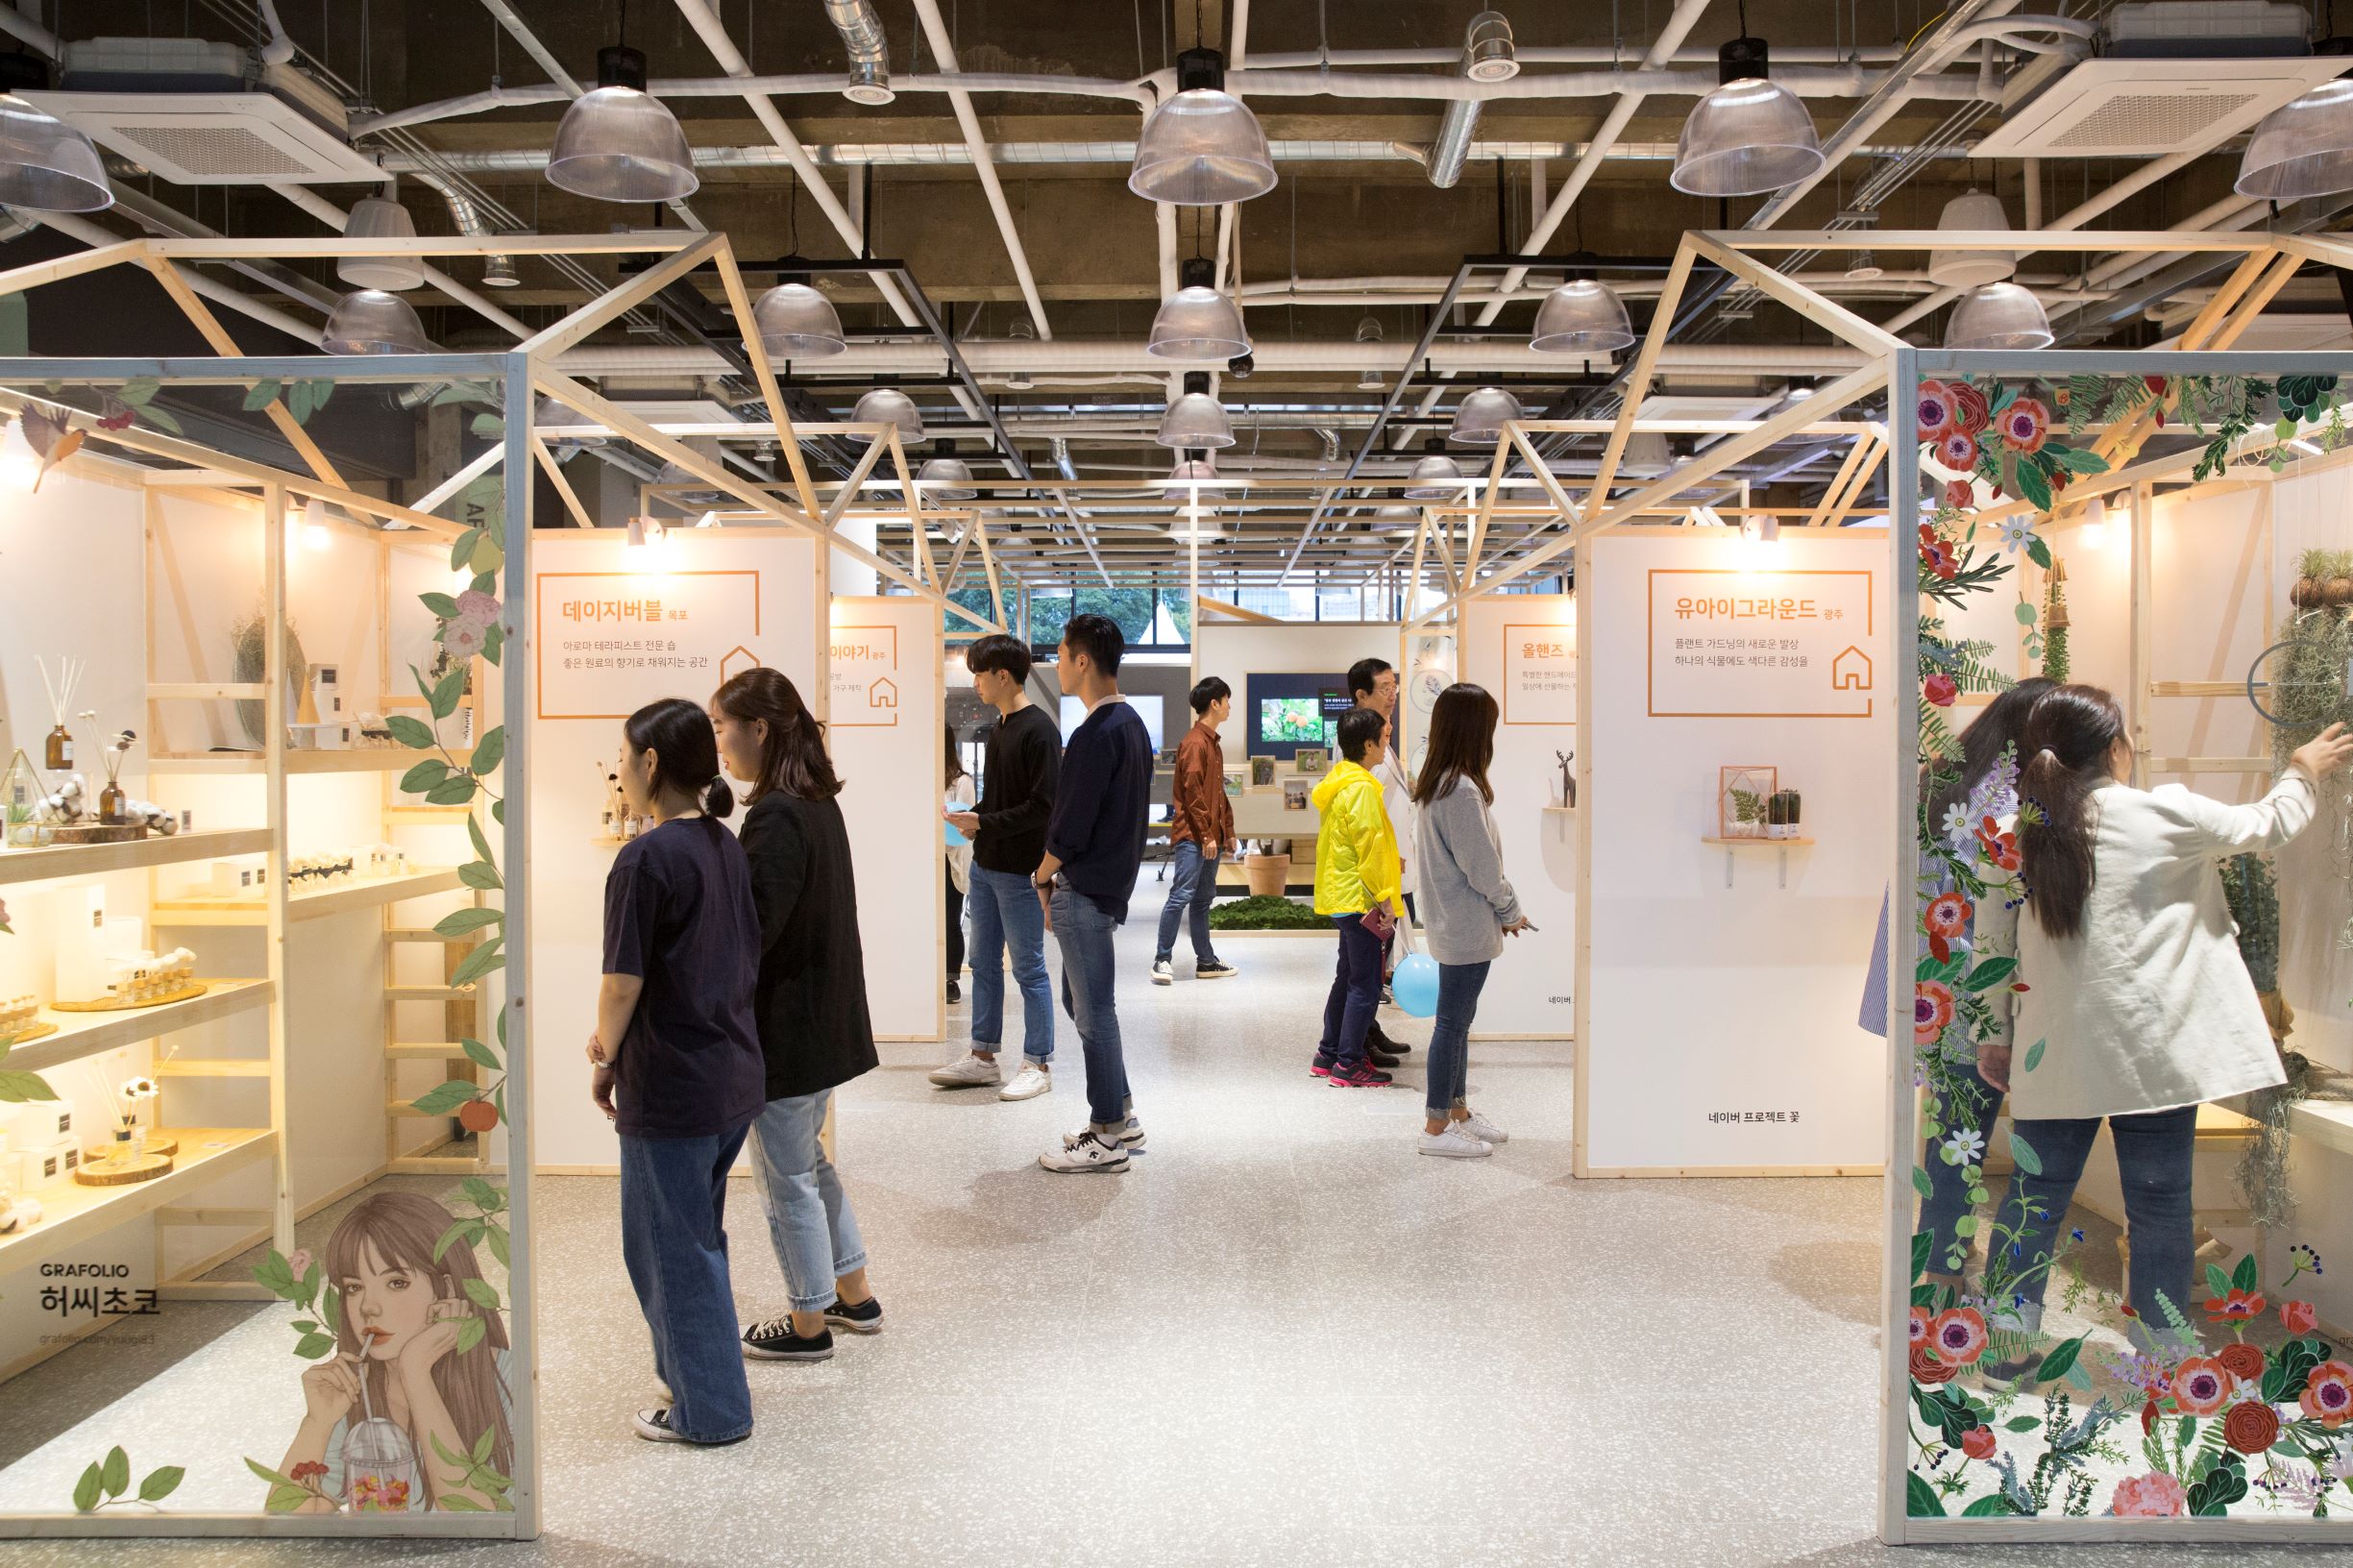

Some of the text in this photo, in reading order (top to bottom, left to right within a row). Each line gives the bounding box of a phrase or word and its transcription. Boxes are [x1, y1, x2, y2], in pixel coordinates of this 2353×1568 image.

[562, 600, 689, 622] 데이지버블 목포
[1675, 598, 1844, 621] 유아이그라운드 광주
[563, 640, 592, 651] 아로마
[594, 640, 643, 651] 테라피스트
[645, 640, 664, 651] 전문
[1675, 638, 1800, 649] 플랜트 가드닝의 새로운 발상
[1521, 642, 1564, 659] 올핸즈
[563, 656, 708, 669] 좋은 원료의 향기로 채워지는 공간
[1675, 655, 1808, 667] 하나의 식물에도 색다른 감성을
[1548, 995, 1571, 1005] 네이버
[1708, 1111, 1801, 1124] 네이버 프로젝트 꽃
[39, 1263, 130, 1278] GRAFOLIO
[39, 1286, 161, 1318] 허씨초코
